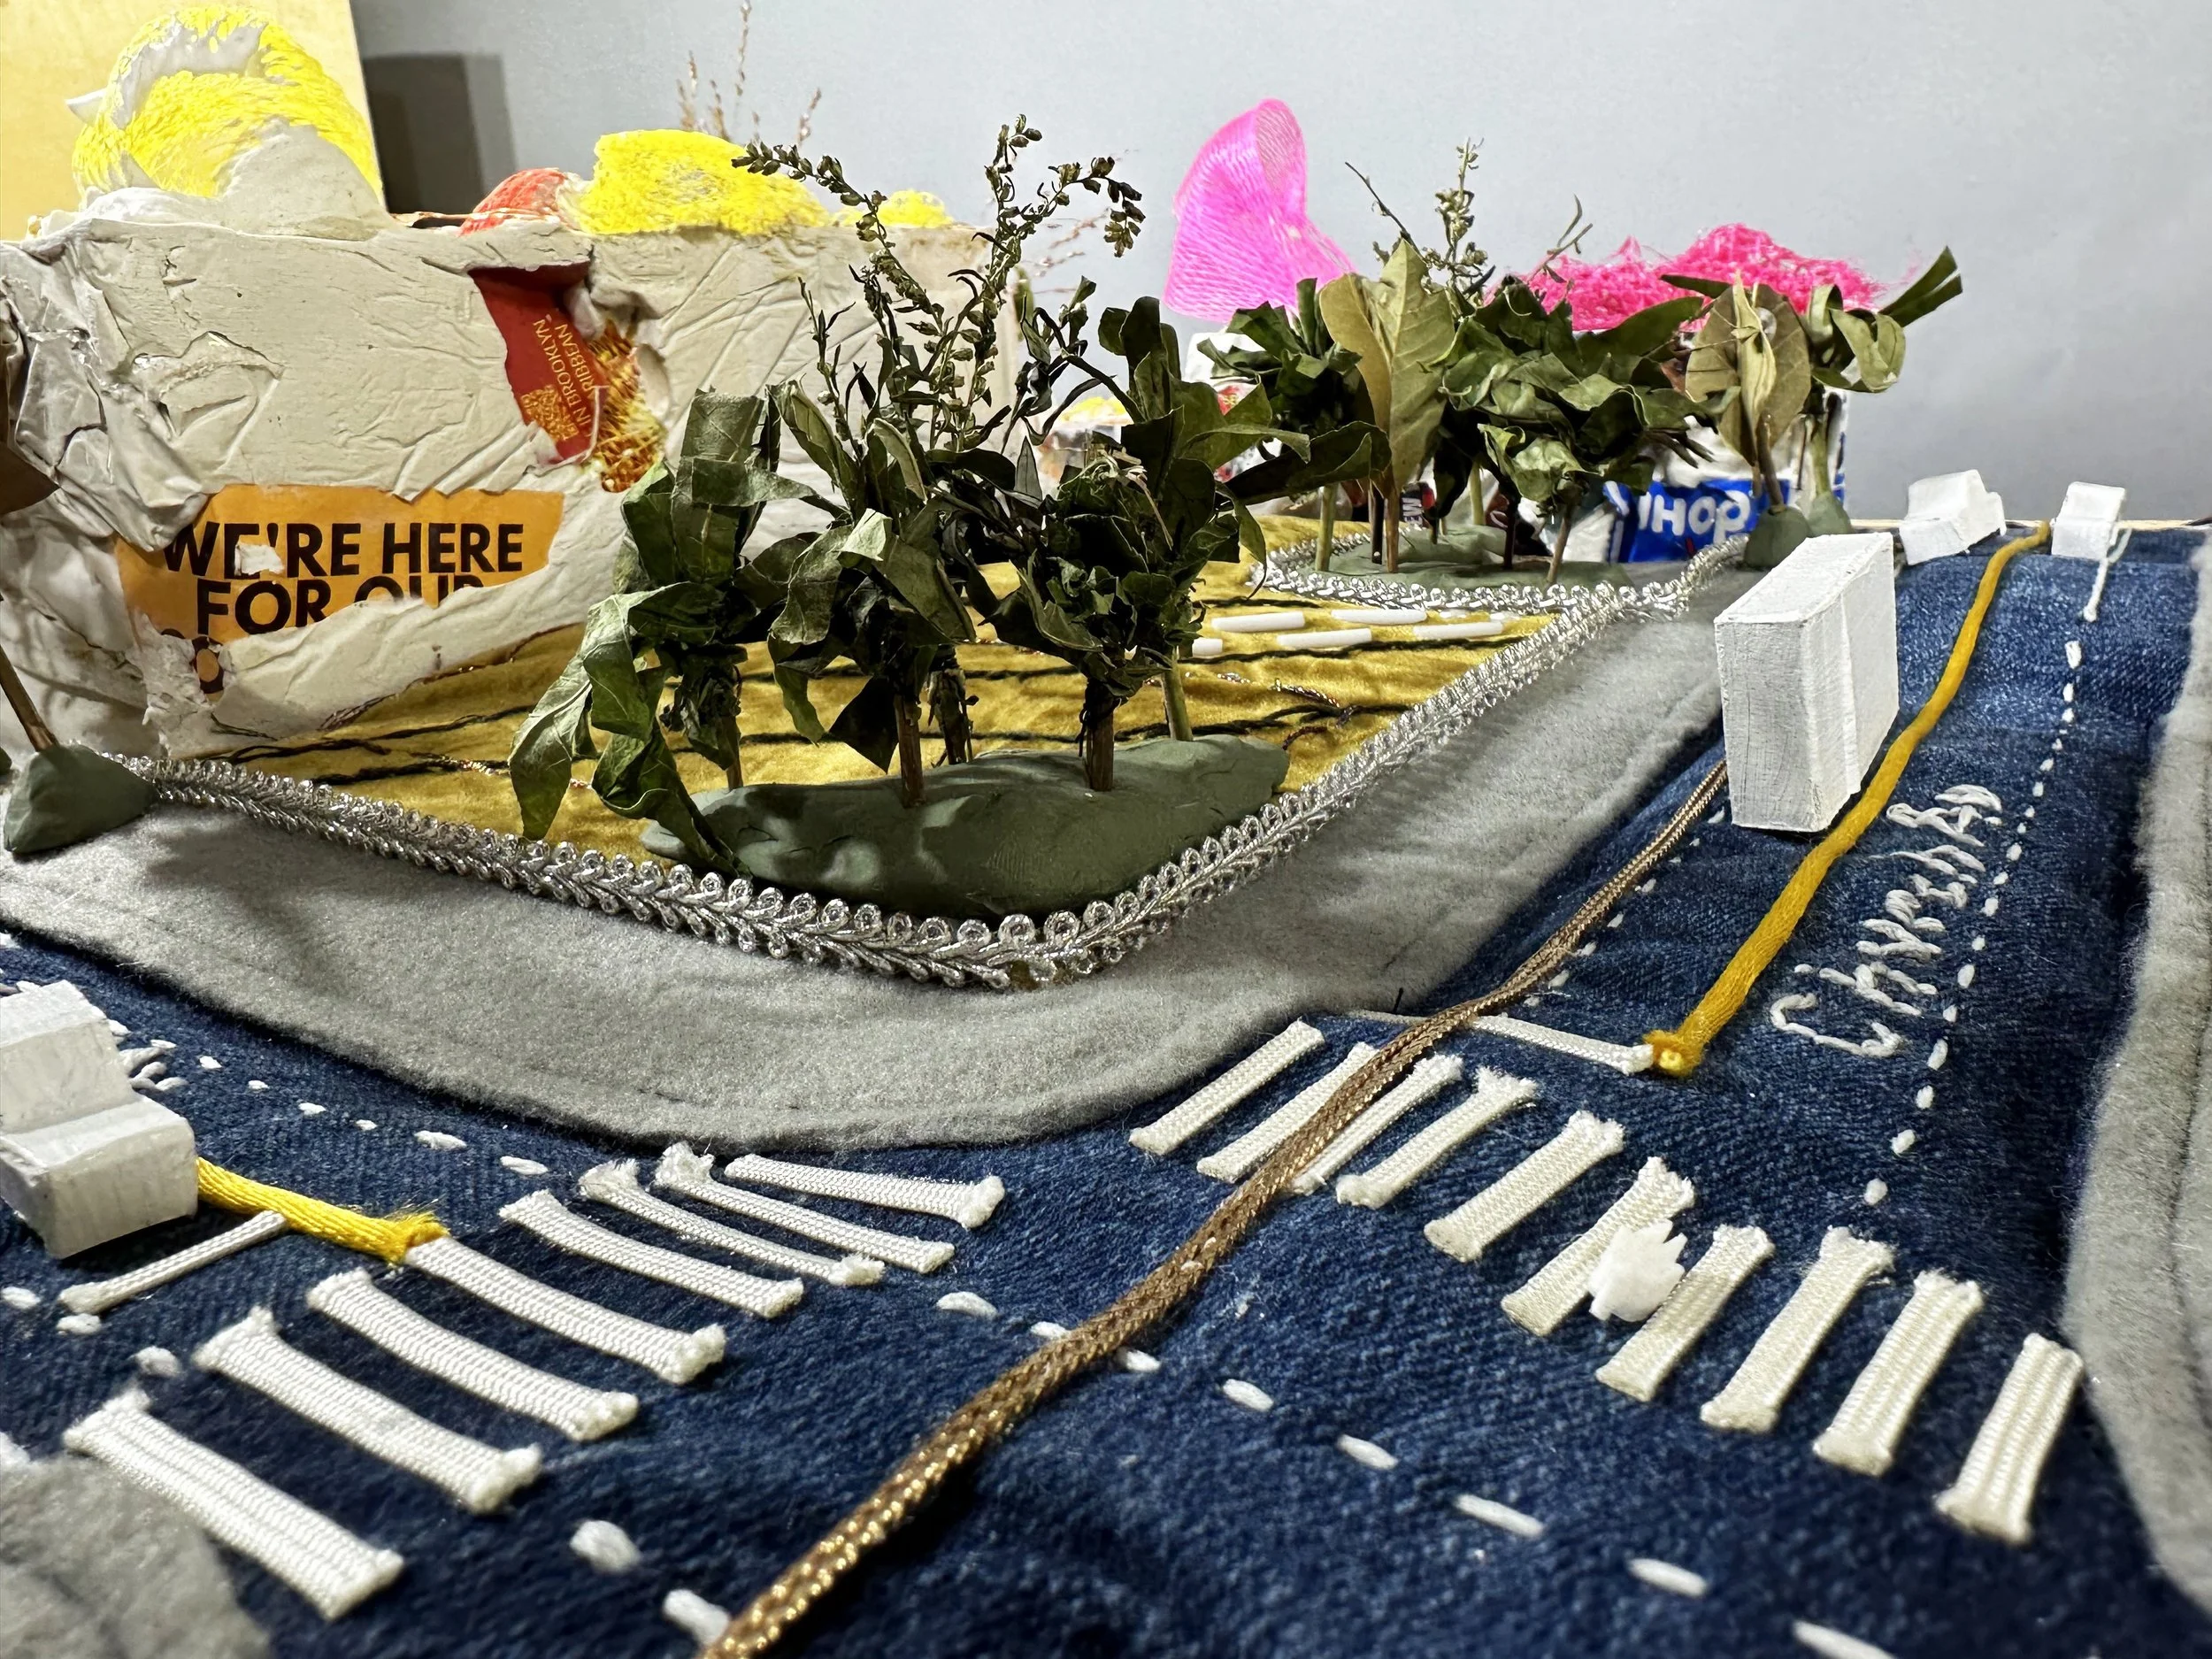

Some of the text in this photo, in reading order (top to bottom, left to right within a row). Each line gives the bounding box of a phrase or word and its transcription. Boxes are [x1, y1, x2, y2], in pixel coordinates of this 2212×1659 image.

[533, 319, 581, 407] BROOKLYN
[573, 407, 592, 425] IN
[165, 523, 524, 580] WE'RE HERE
[196, 575, 484, 635] FOR OU
